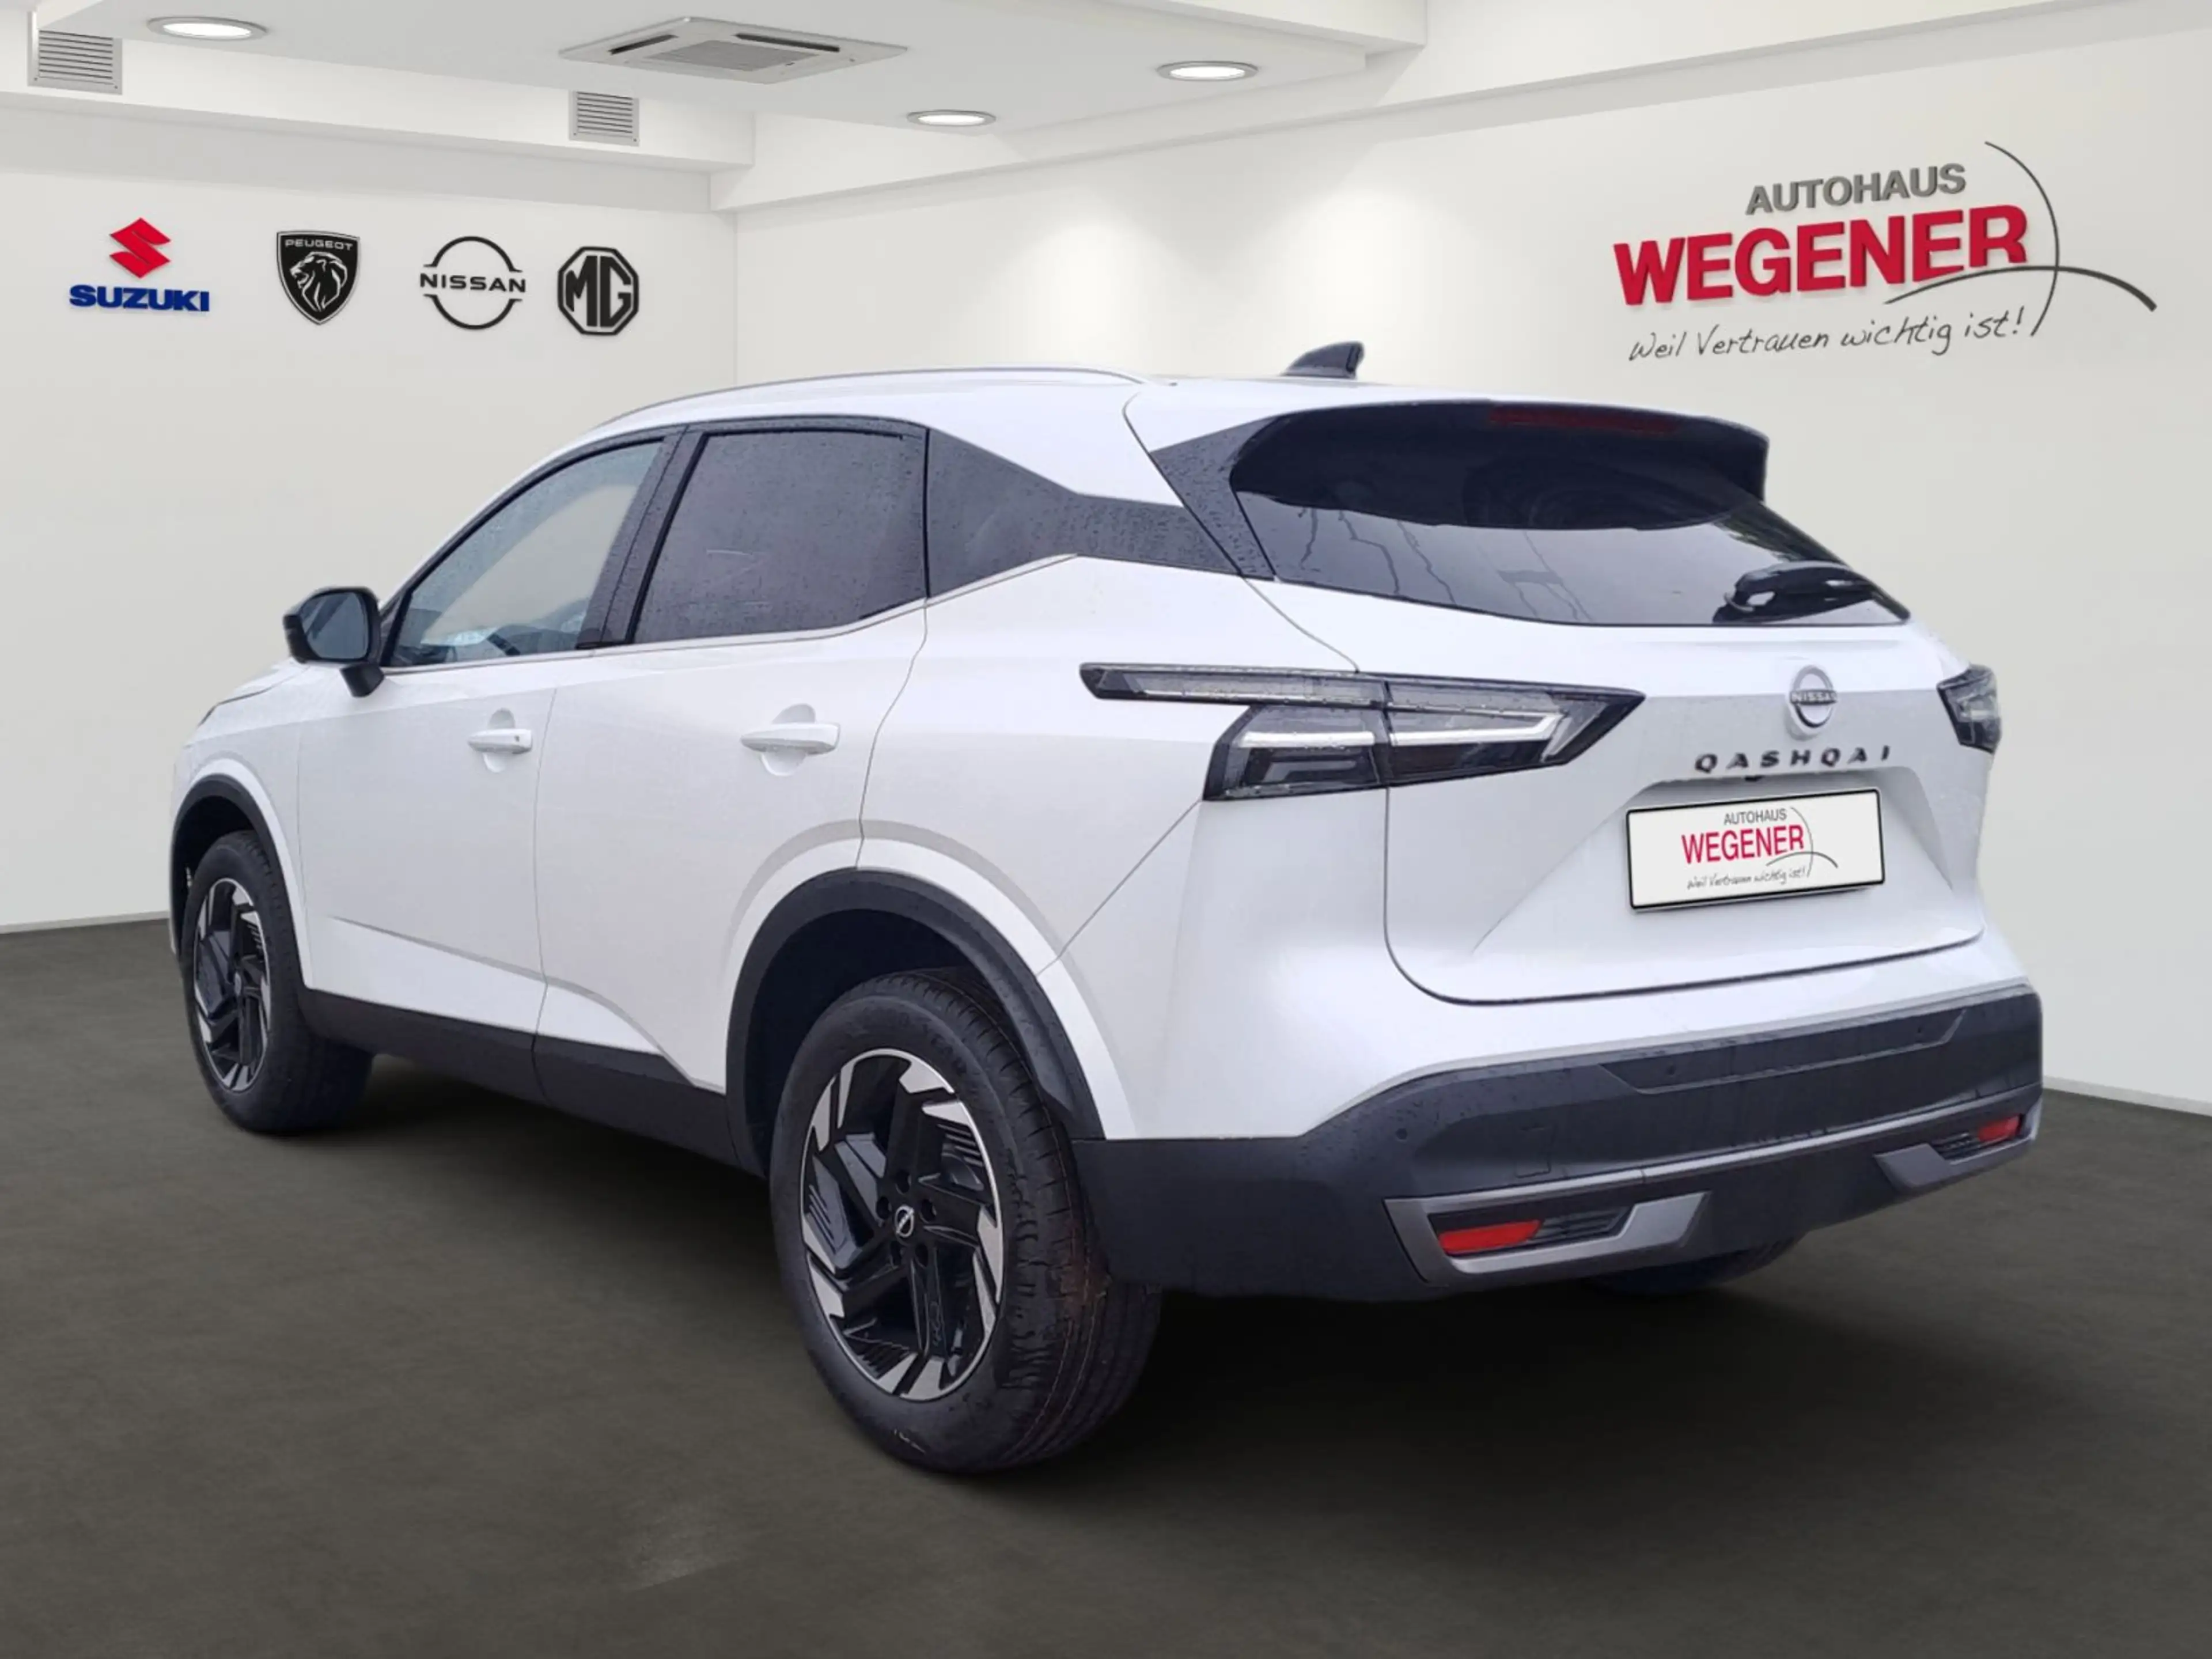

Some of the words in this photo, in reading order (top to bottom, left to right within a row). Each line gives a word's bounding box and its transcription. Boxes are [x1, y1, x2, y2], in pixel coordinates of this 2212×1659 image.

[1745, 164, 1966, 215] AUTOHAUS
[285, 238, 354, 252] PEUGEOT
[1613, 204, 2028, 306] WEGENER
[70, 284, 210, 312] SUZUKI
[419, 272, 527, 293] NISSAN
[566, 255, 632, 328] MG
[1628, 331, 1687, 362] Weil
[1696, 323, 1830, 356] Vertrauen
[1840, 315, 1952, 356] wichtig
[1964, 305, 2025, 339] ist!
[1694, 745, 1891, 774] QASHQAI
[1724, 808, 1787, 825] AUTOHAUS
[1681, 824, 1804, 864] WEGENER
